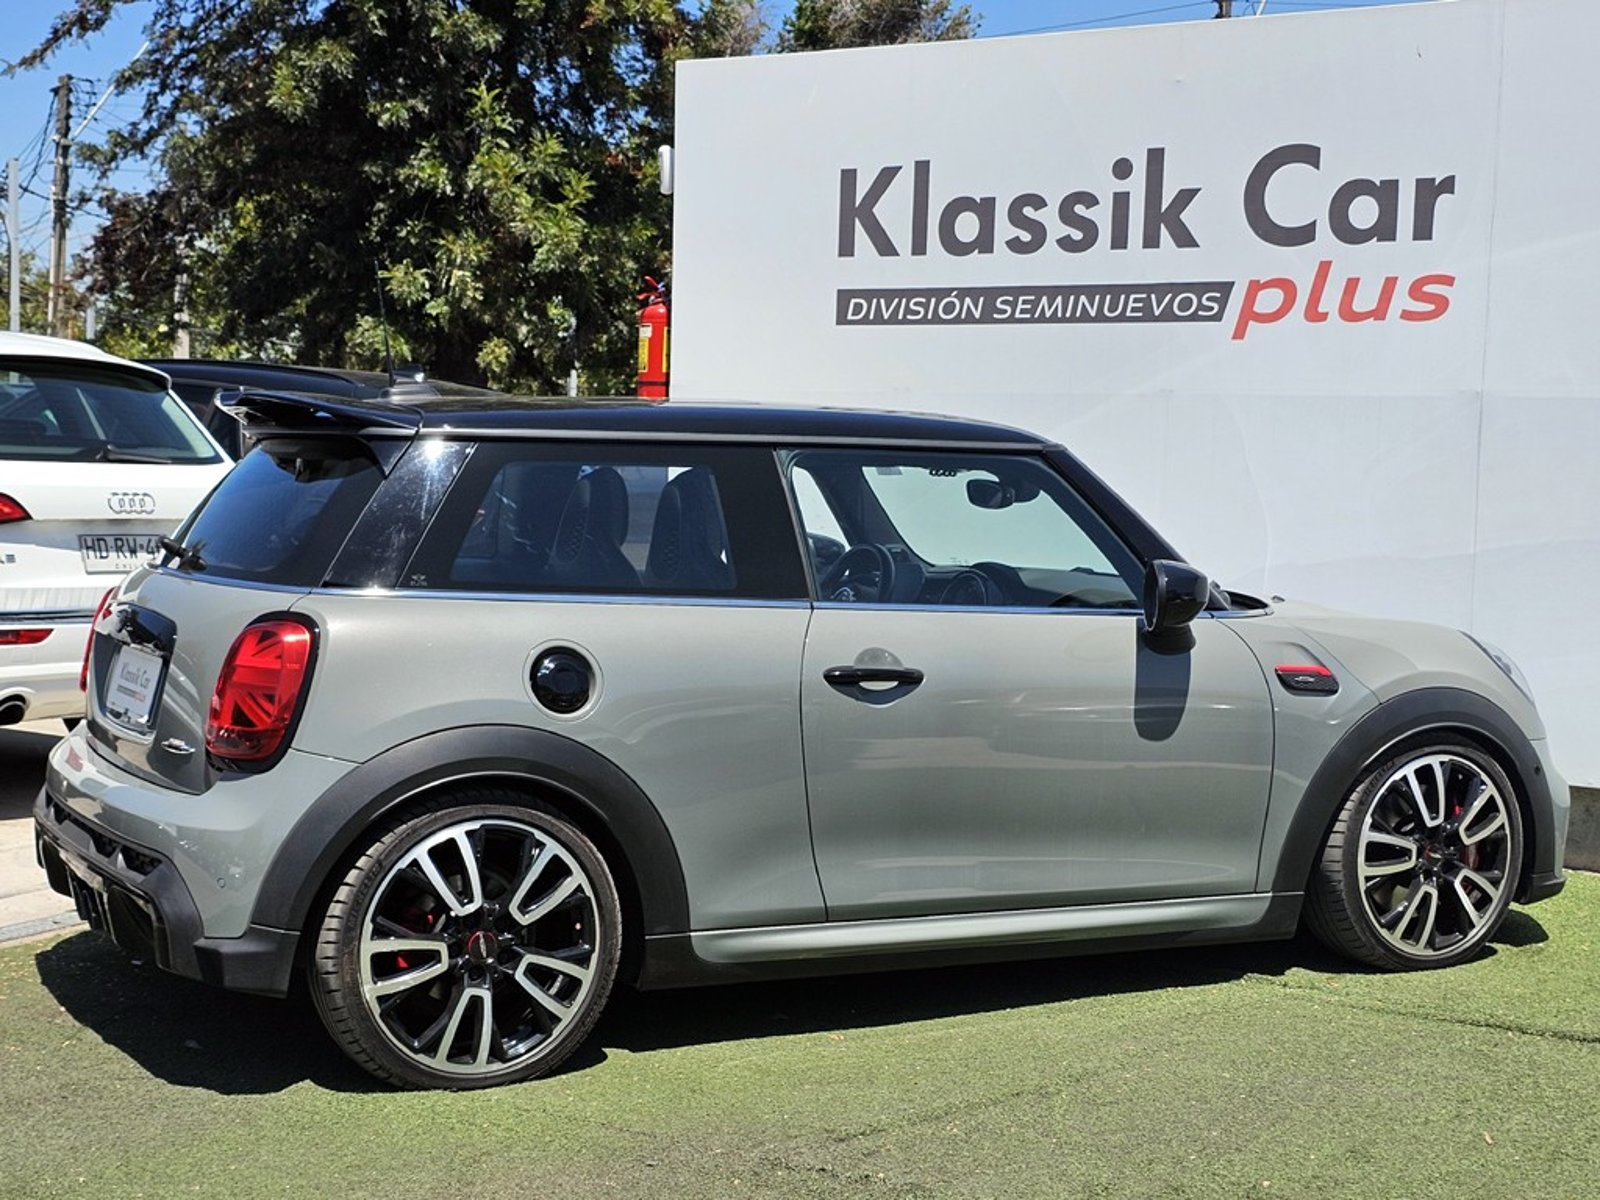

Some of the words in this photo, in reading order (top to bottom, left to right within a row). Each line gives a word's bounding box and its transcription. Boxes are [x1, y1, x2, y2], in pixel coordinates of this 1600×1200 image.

[836, 147, 1202, 258] Klassik
[1242, 143, 1456, 248] Car
[846, 290, 984, 321] DIVISIÓN
[993, 292, 1222, 319] SEMINUEVOS
[1231, 260, 1456, 340] plus
